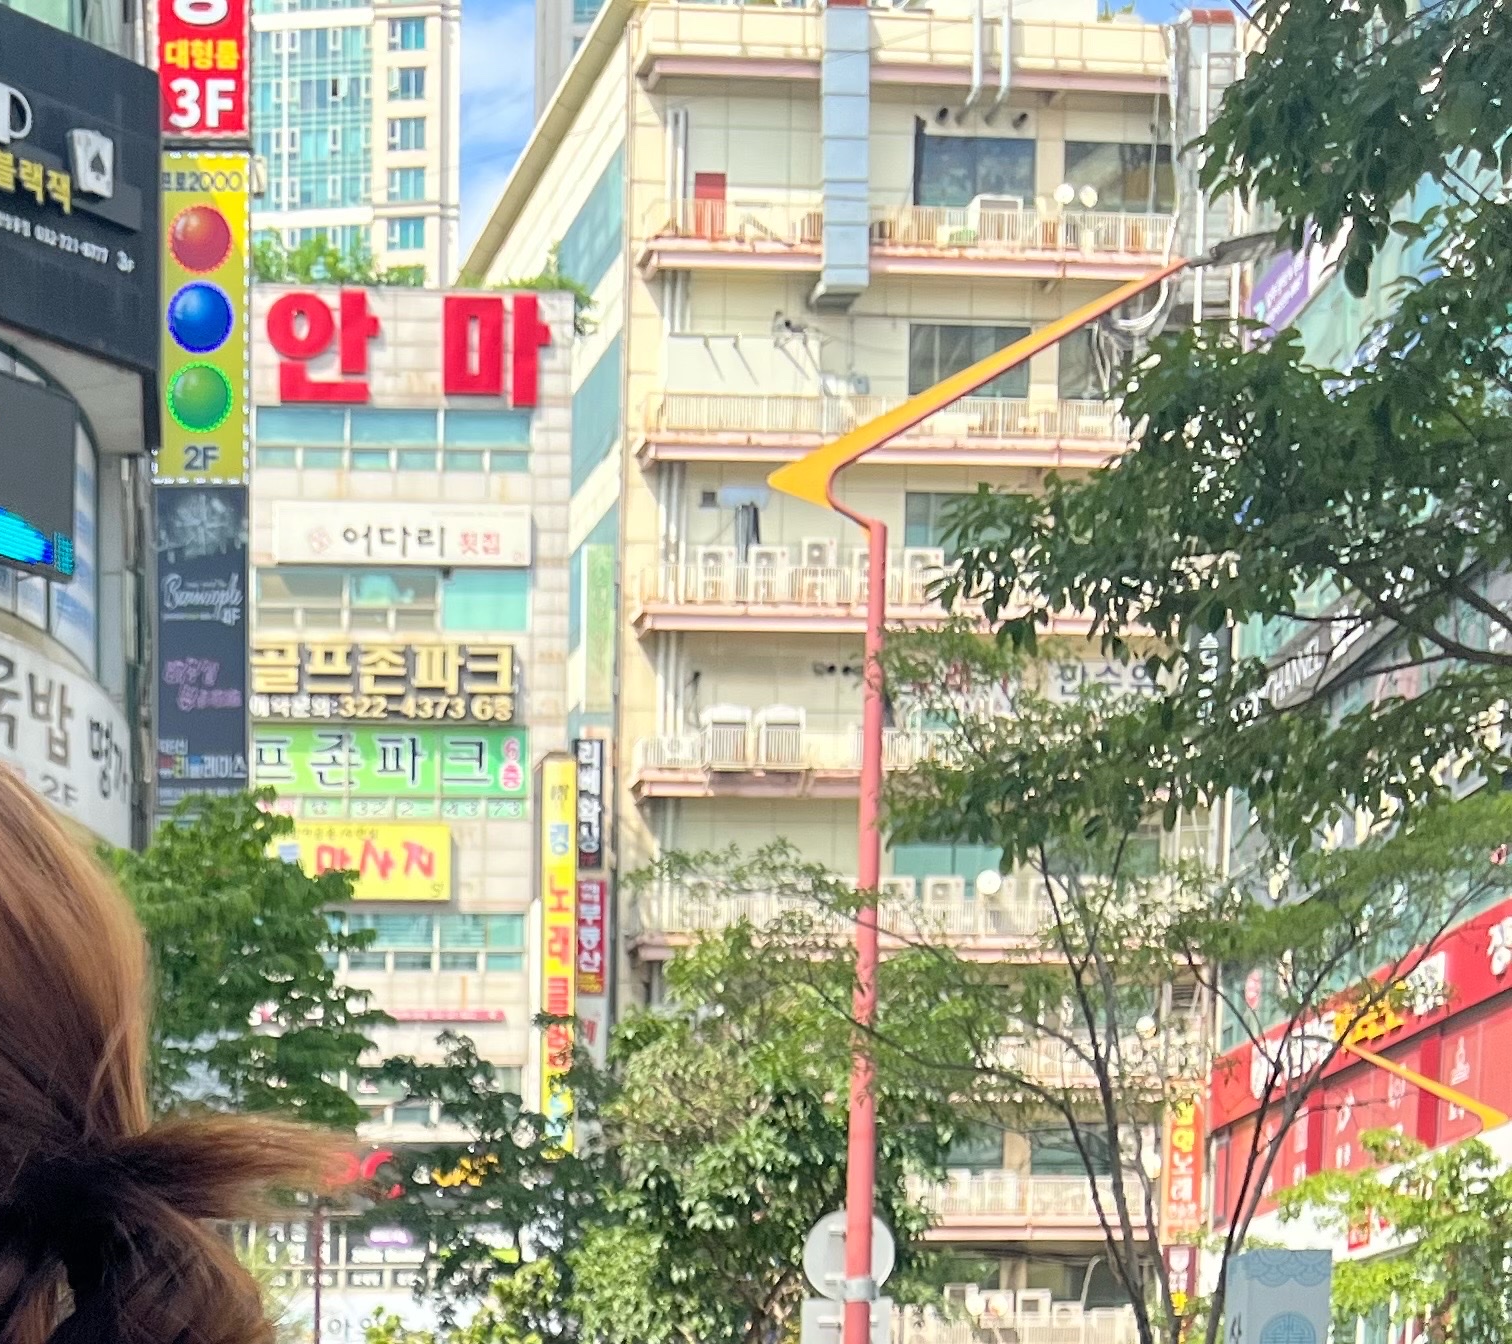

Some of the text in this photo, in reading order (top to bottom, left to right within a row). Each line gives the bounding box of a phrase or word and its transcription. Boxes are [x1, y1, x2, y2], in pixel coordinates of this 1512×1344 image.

[164, 38, 240, 71] 대형룸
[168, 77, 236, 128] 3F
[266, 289, 552, 408] 안마
[183, 445, 220, 471] 2F
[343, 524, 445, 558] 어다리
[250, 642, 516, 697] 골프존파크
[471, 694, 515, 722] 6층
[41, 774, 79, 807] 2F
[315, 838, 436, 880] 마사지
